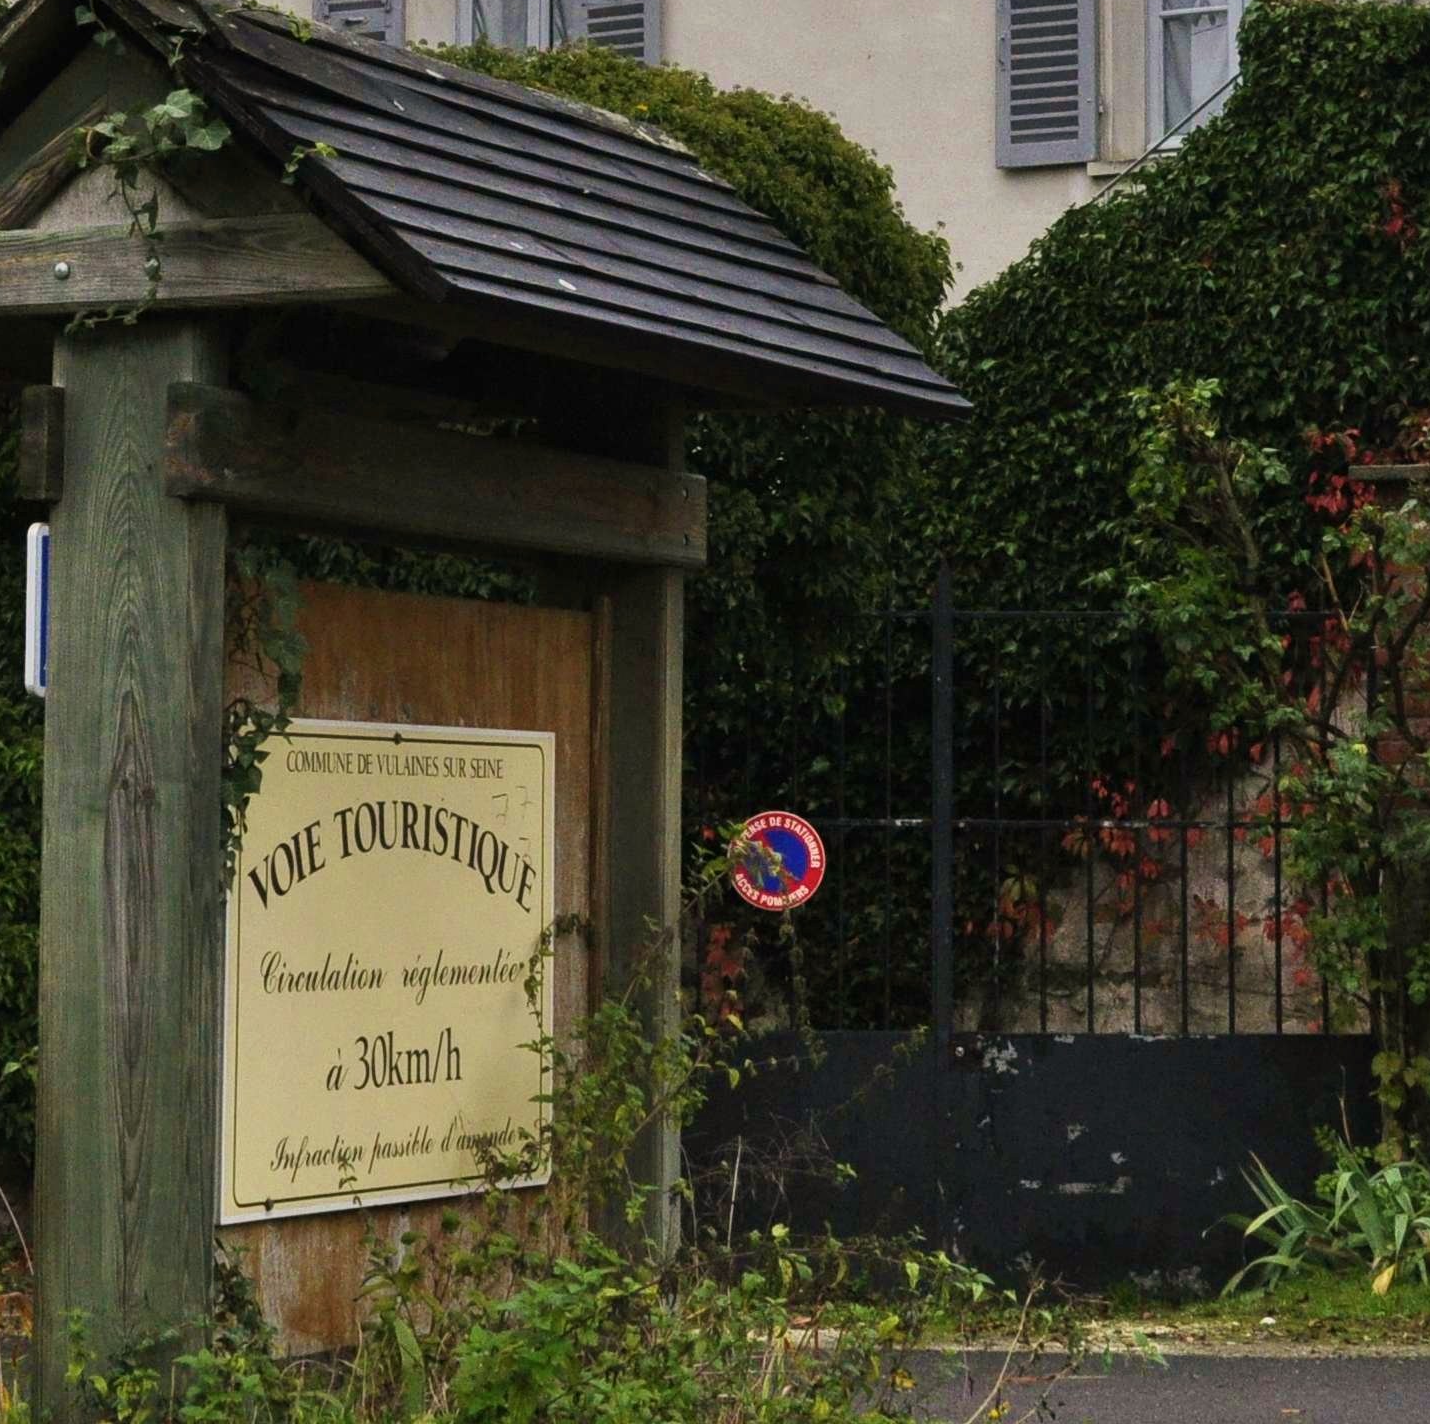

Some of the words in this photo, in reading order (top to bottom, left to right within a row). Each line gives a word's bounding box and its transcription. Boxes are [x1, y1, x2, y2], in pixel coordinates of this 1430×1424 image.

[286, 750, 353, 774] COMMUNE
[357, 753, 372, 774] DE
[377, 754, 438, 776] VULAINES
[443, 756, 466, 777] SUR
[471, 758, 503, 779] SEINE
[769, 816, 782, 826] DE
[248, 820, 326, 910] VOIE
[333, 800, 536, 913] TOURISTIQUE
[760, 884, 809, 907] POMIERS
[260, 951, 387, 993] Circulation
[402, 948, 522, 1006] réglementée
[326, 1048, 348, 1091] à
[353, 1027, 462, 1090] 30km/h
[271, 1134, 363, 1183] Infraction
[368, 1125, 433, 1174] passible
